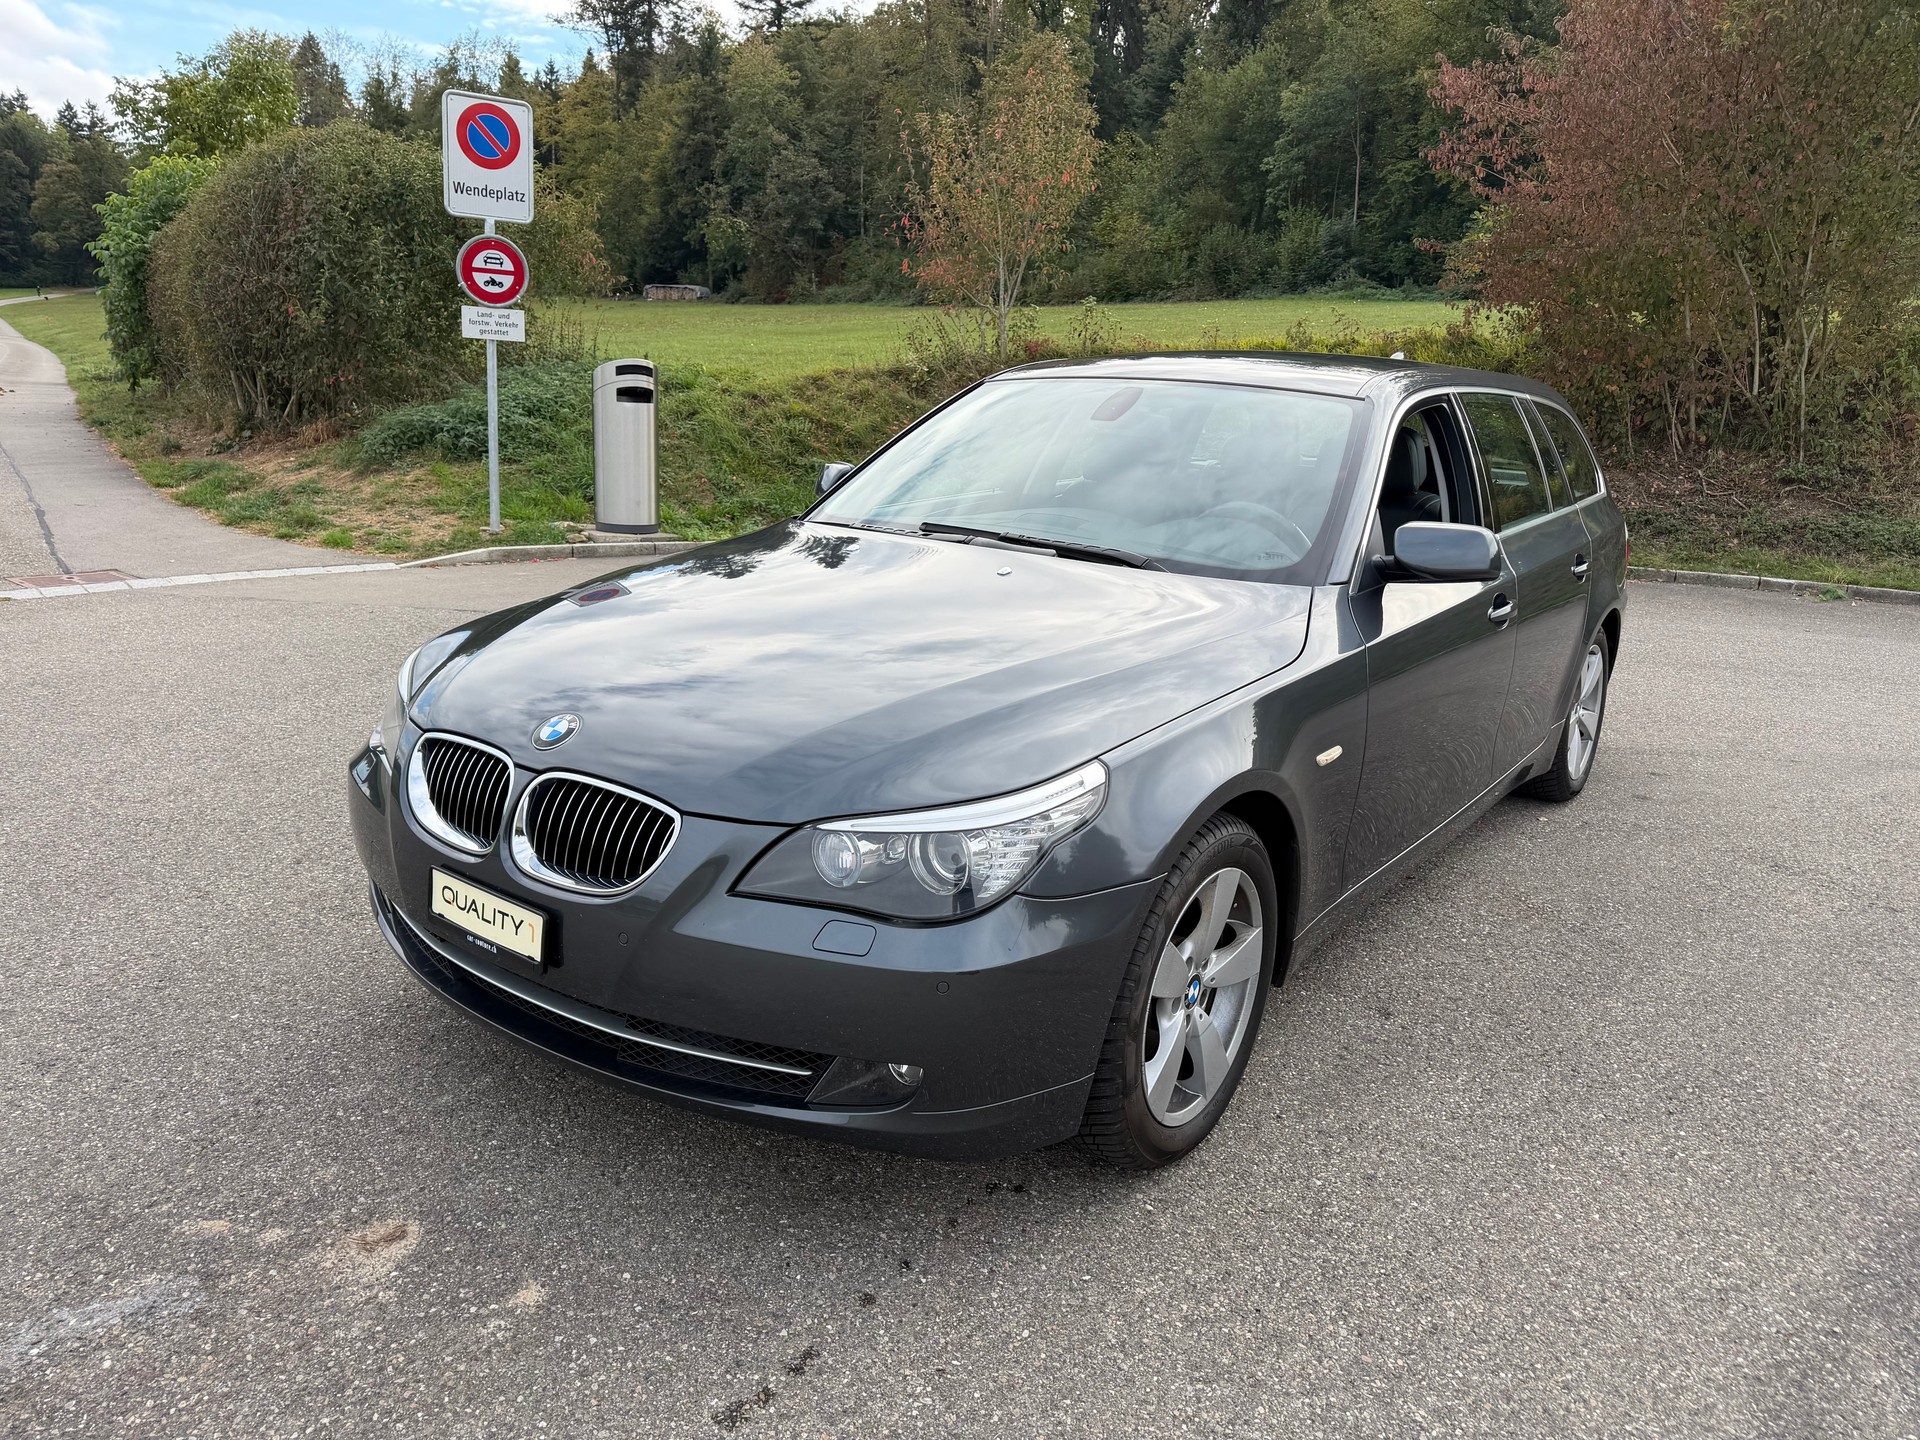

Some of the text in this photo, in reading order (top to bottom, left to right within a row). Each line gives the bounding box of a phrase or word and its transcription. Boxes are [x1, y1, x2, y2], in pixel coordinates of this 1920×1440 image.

[452, 180, 526, 203] Wendeplatz
[476, 310, 511, 320] Land- und
[468, 317, 519, 328] forstw. Verkehr
[479, 328, 509, 336] gestattet
[441, 885, 524, 936] QUALITY
